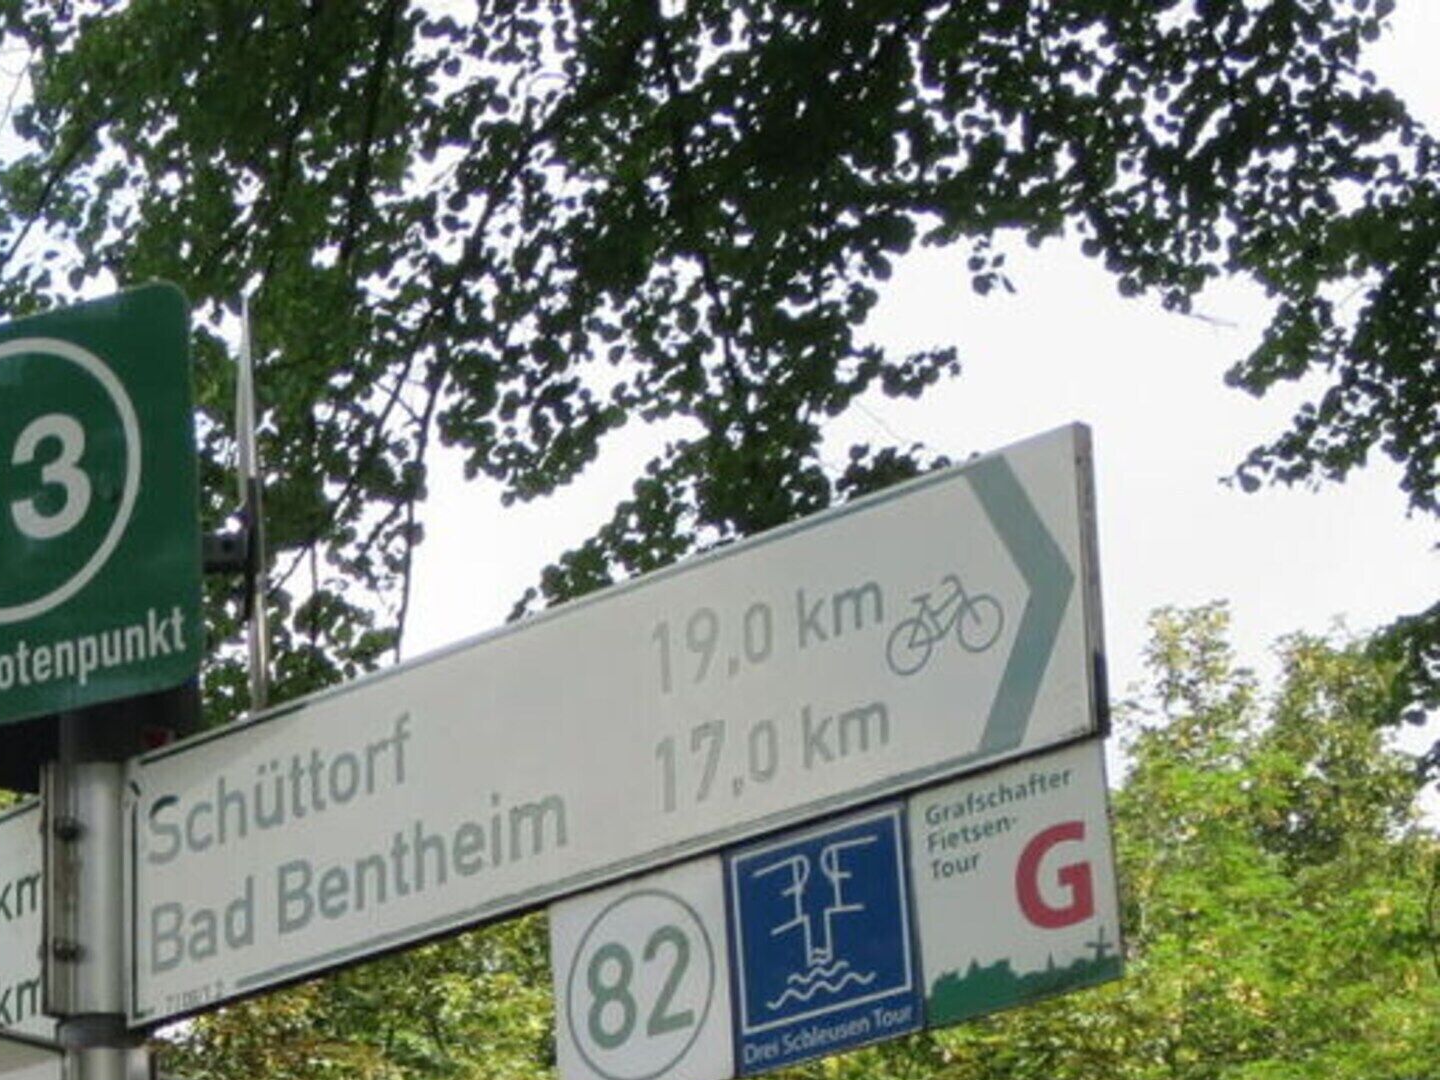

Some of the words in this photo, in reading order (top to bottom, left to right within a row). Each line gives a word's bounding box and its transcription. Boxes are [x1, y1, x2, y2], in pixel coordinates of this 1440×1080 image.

[651, 602, 775, 693] 19,0
[798, 581, 883, 649] km
[148, 712, 411, 864] Schüttorf
[656, 718, 779, 812] 17,0
[804, 701, 890, 769] km
[925, 769, 1072, 825] Grafschafter
[151, 876, 254, 974] Bad
[277, 792, 567, 935] Bentheim
[927, 816, 1017, 853] Fietsen-
[931, 854, 980, 879] Tour
[1015, 821, 1095, 930] G
[586, 924, 694, 1049] 82
[744, 1042, 778, 1064] Drei
[873, 1005, 912, 1028] Tour
